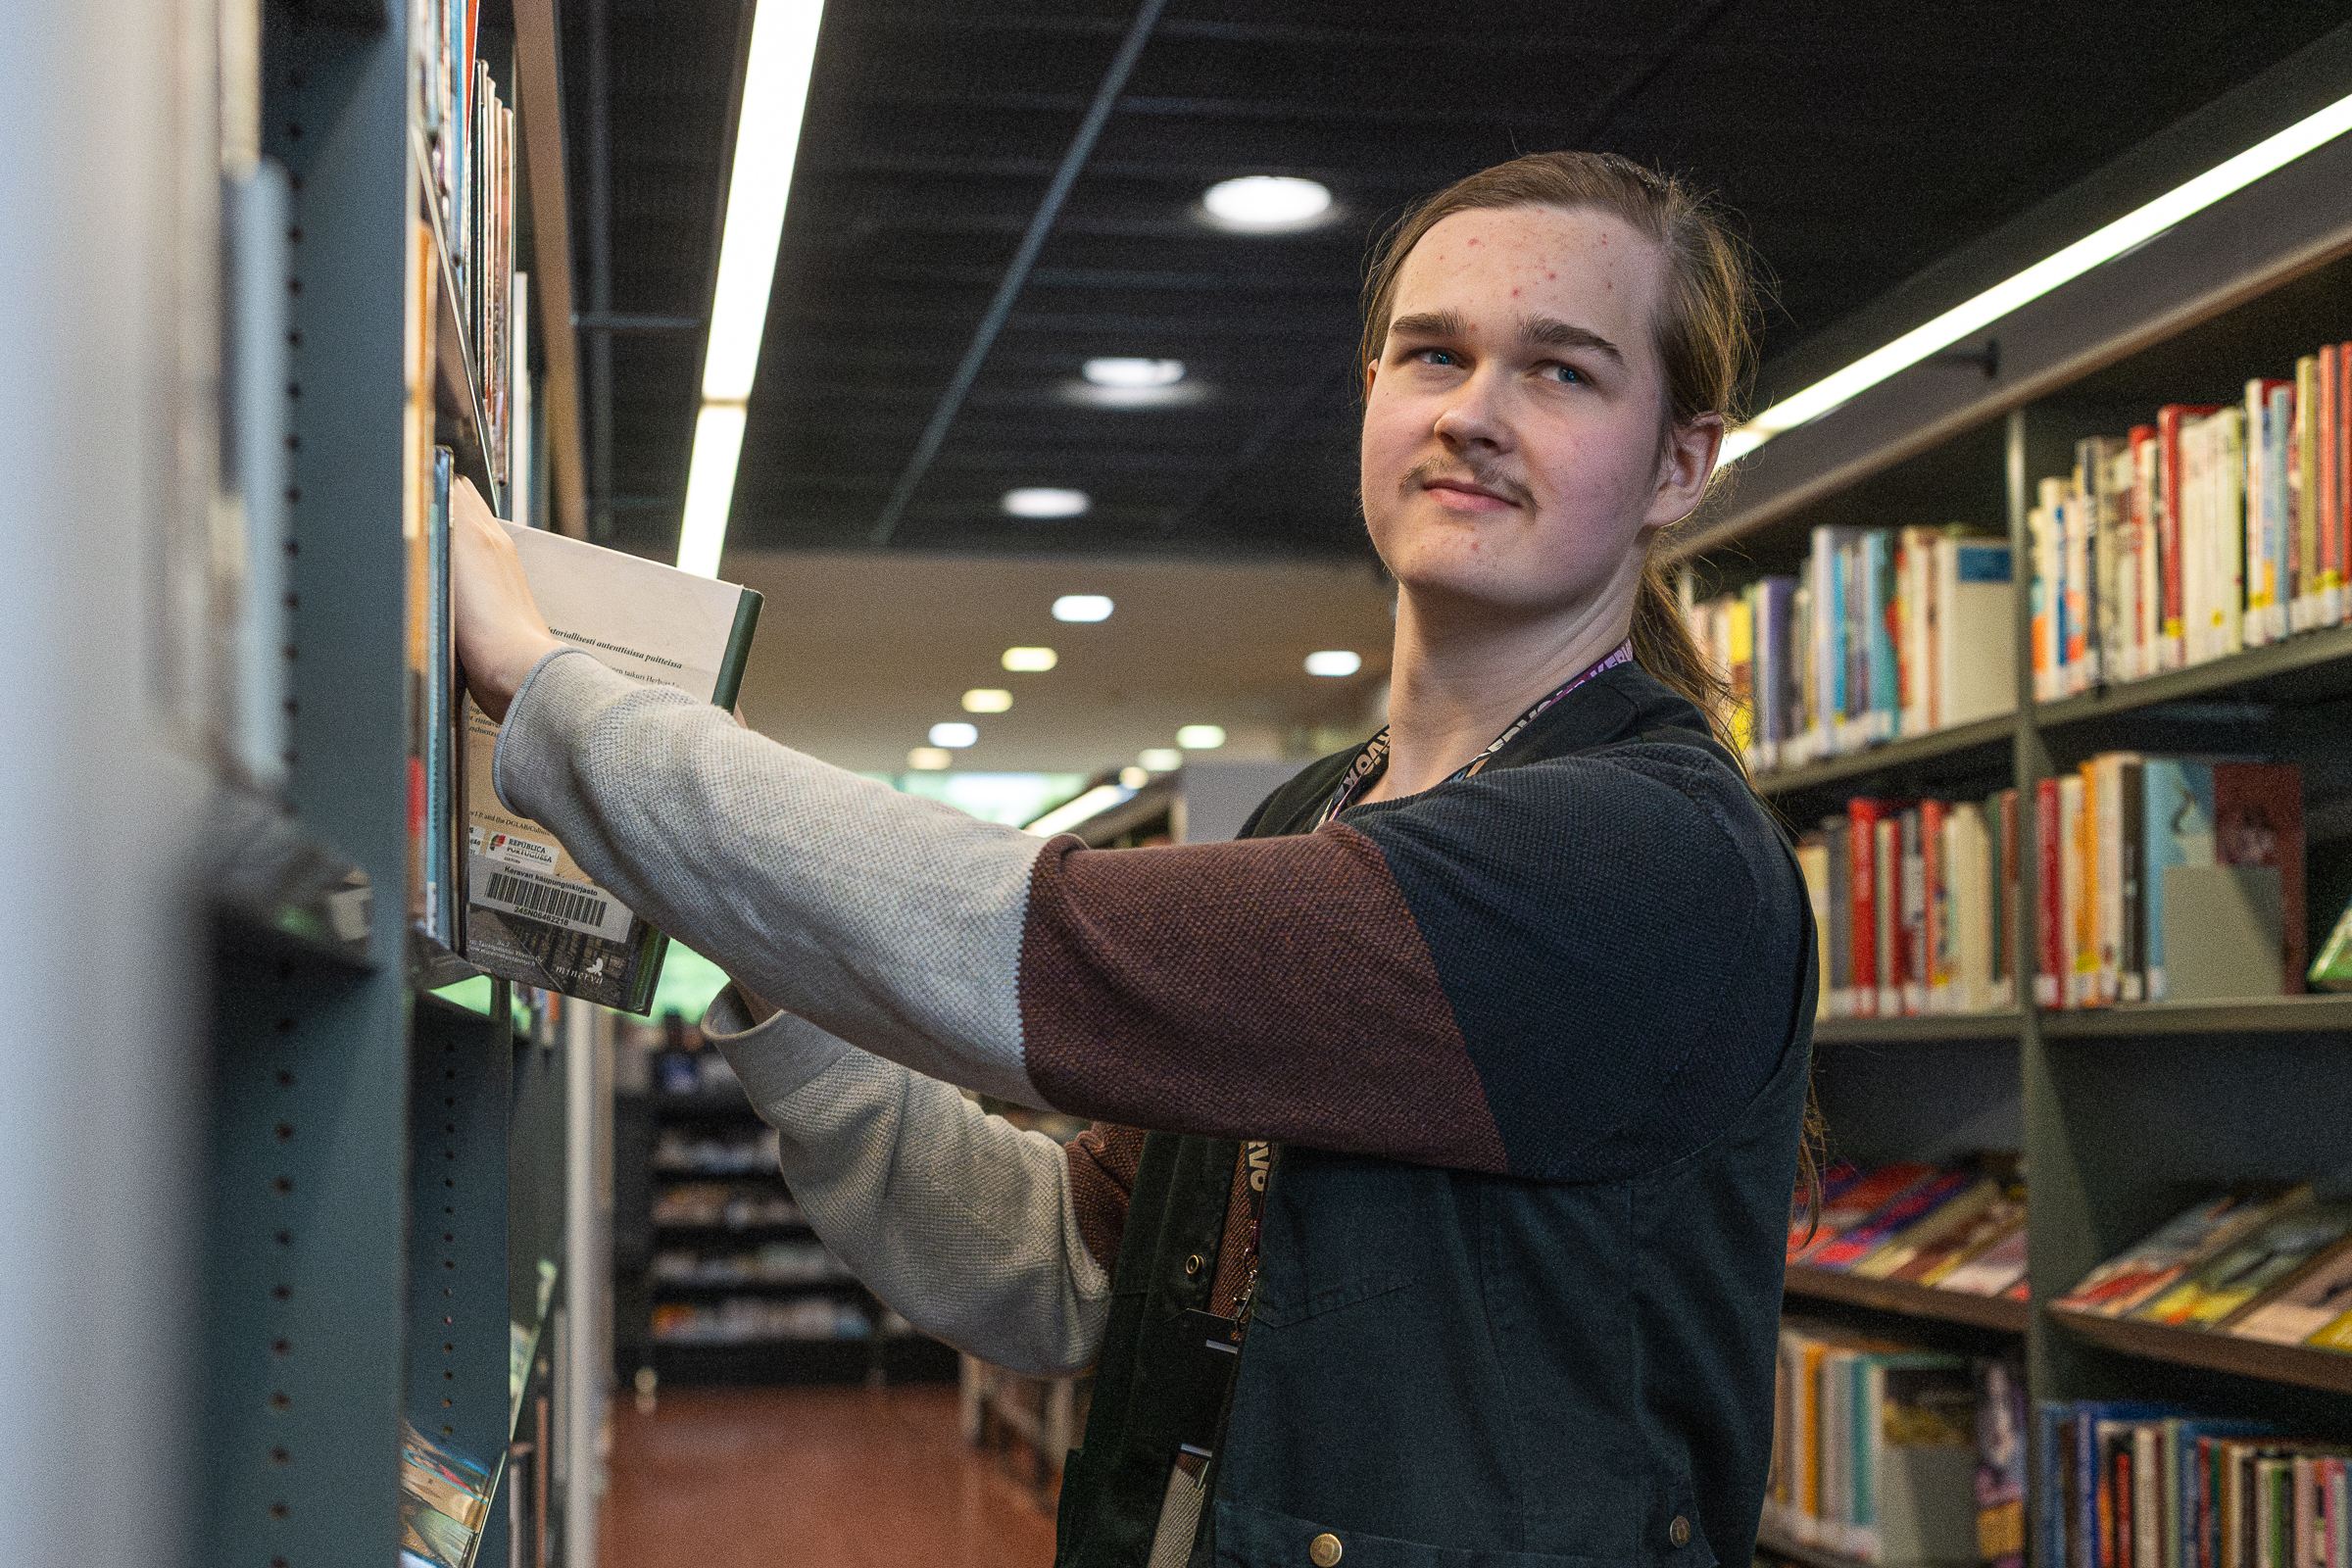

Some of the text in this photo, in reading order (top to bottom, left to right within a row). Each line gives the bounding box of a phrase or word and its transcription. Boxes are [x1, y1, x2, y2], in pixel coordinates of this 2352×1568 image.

[549, 627, 683, 669] storiallisesti autenttisissa puitteissa
[505, 865, 598, 897] Keravan kaupunginkirjasto
